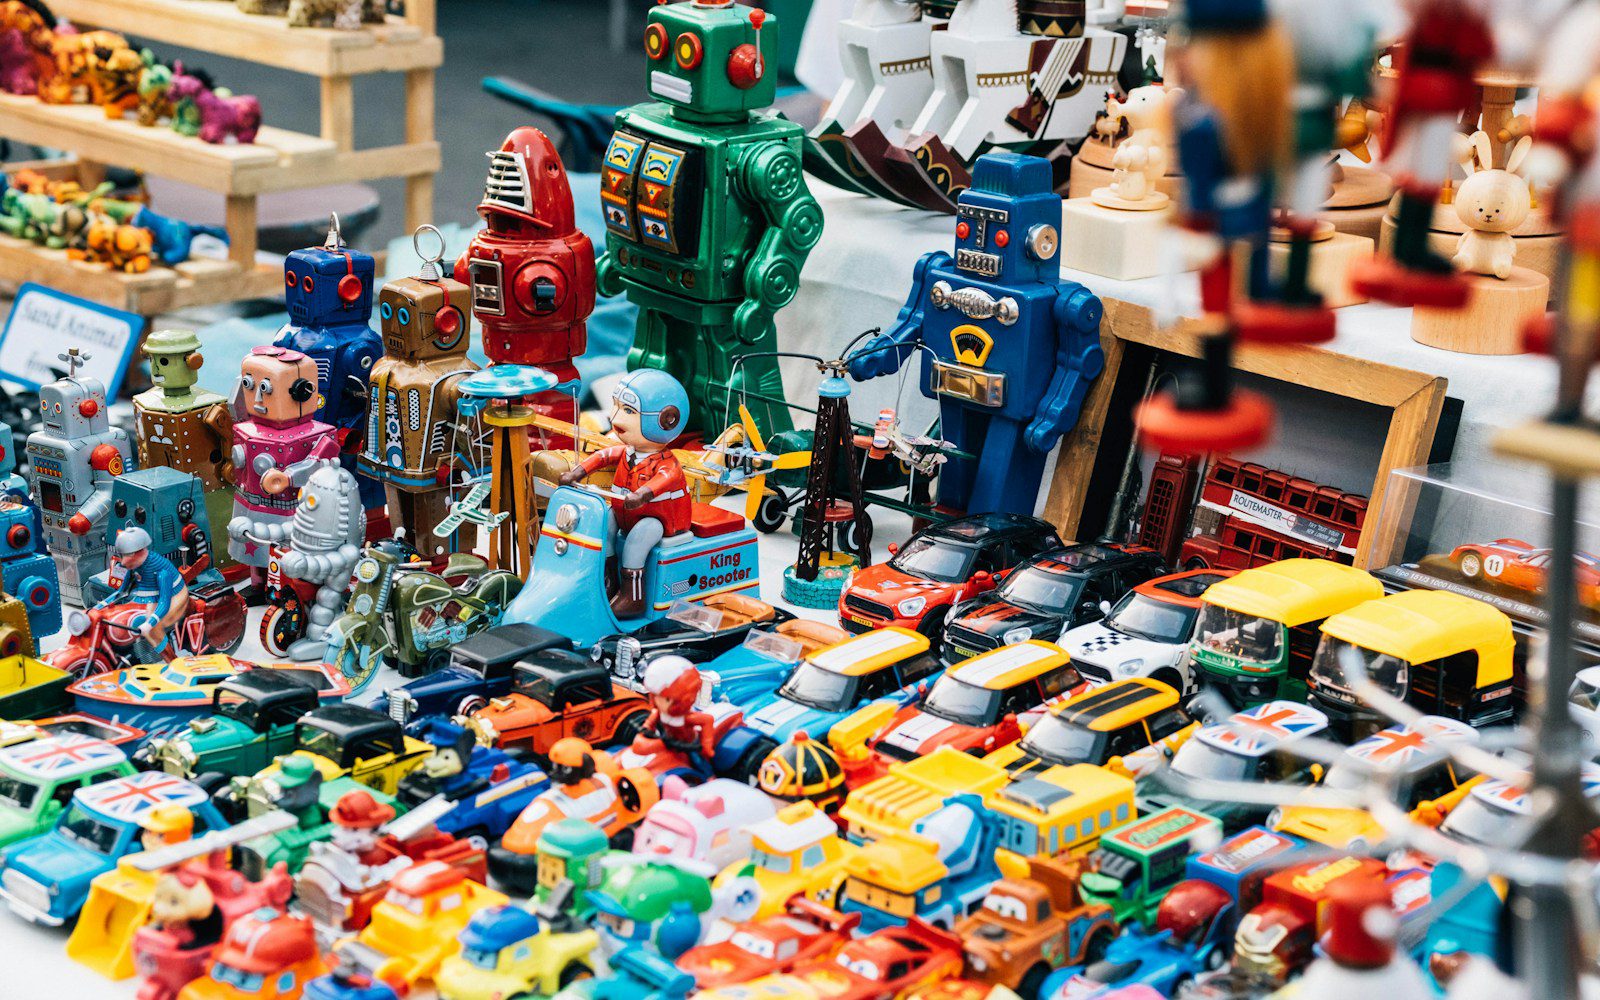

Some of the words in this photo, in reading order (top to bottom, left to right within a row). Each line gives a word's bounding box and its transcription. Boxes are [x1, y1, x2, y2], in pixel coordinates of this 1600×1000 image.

[1233, 494, 1282, 520] ROUTEMASTER
[709, 552, 741, 569] King
[1488, 558, 1500, 573] 11
[698, 567, 752, 590] Scooter
[1395, 568, 1410, 578] Tipo
[1430, 578, 1448, 588] 1000
[1493, 597, 1512, 608] Paris
